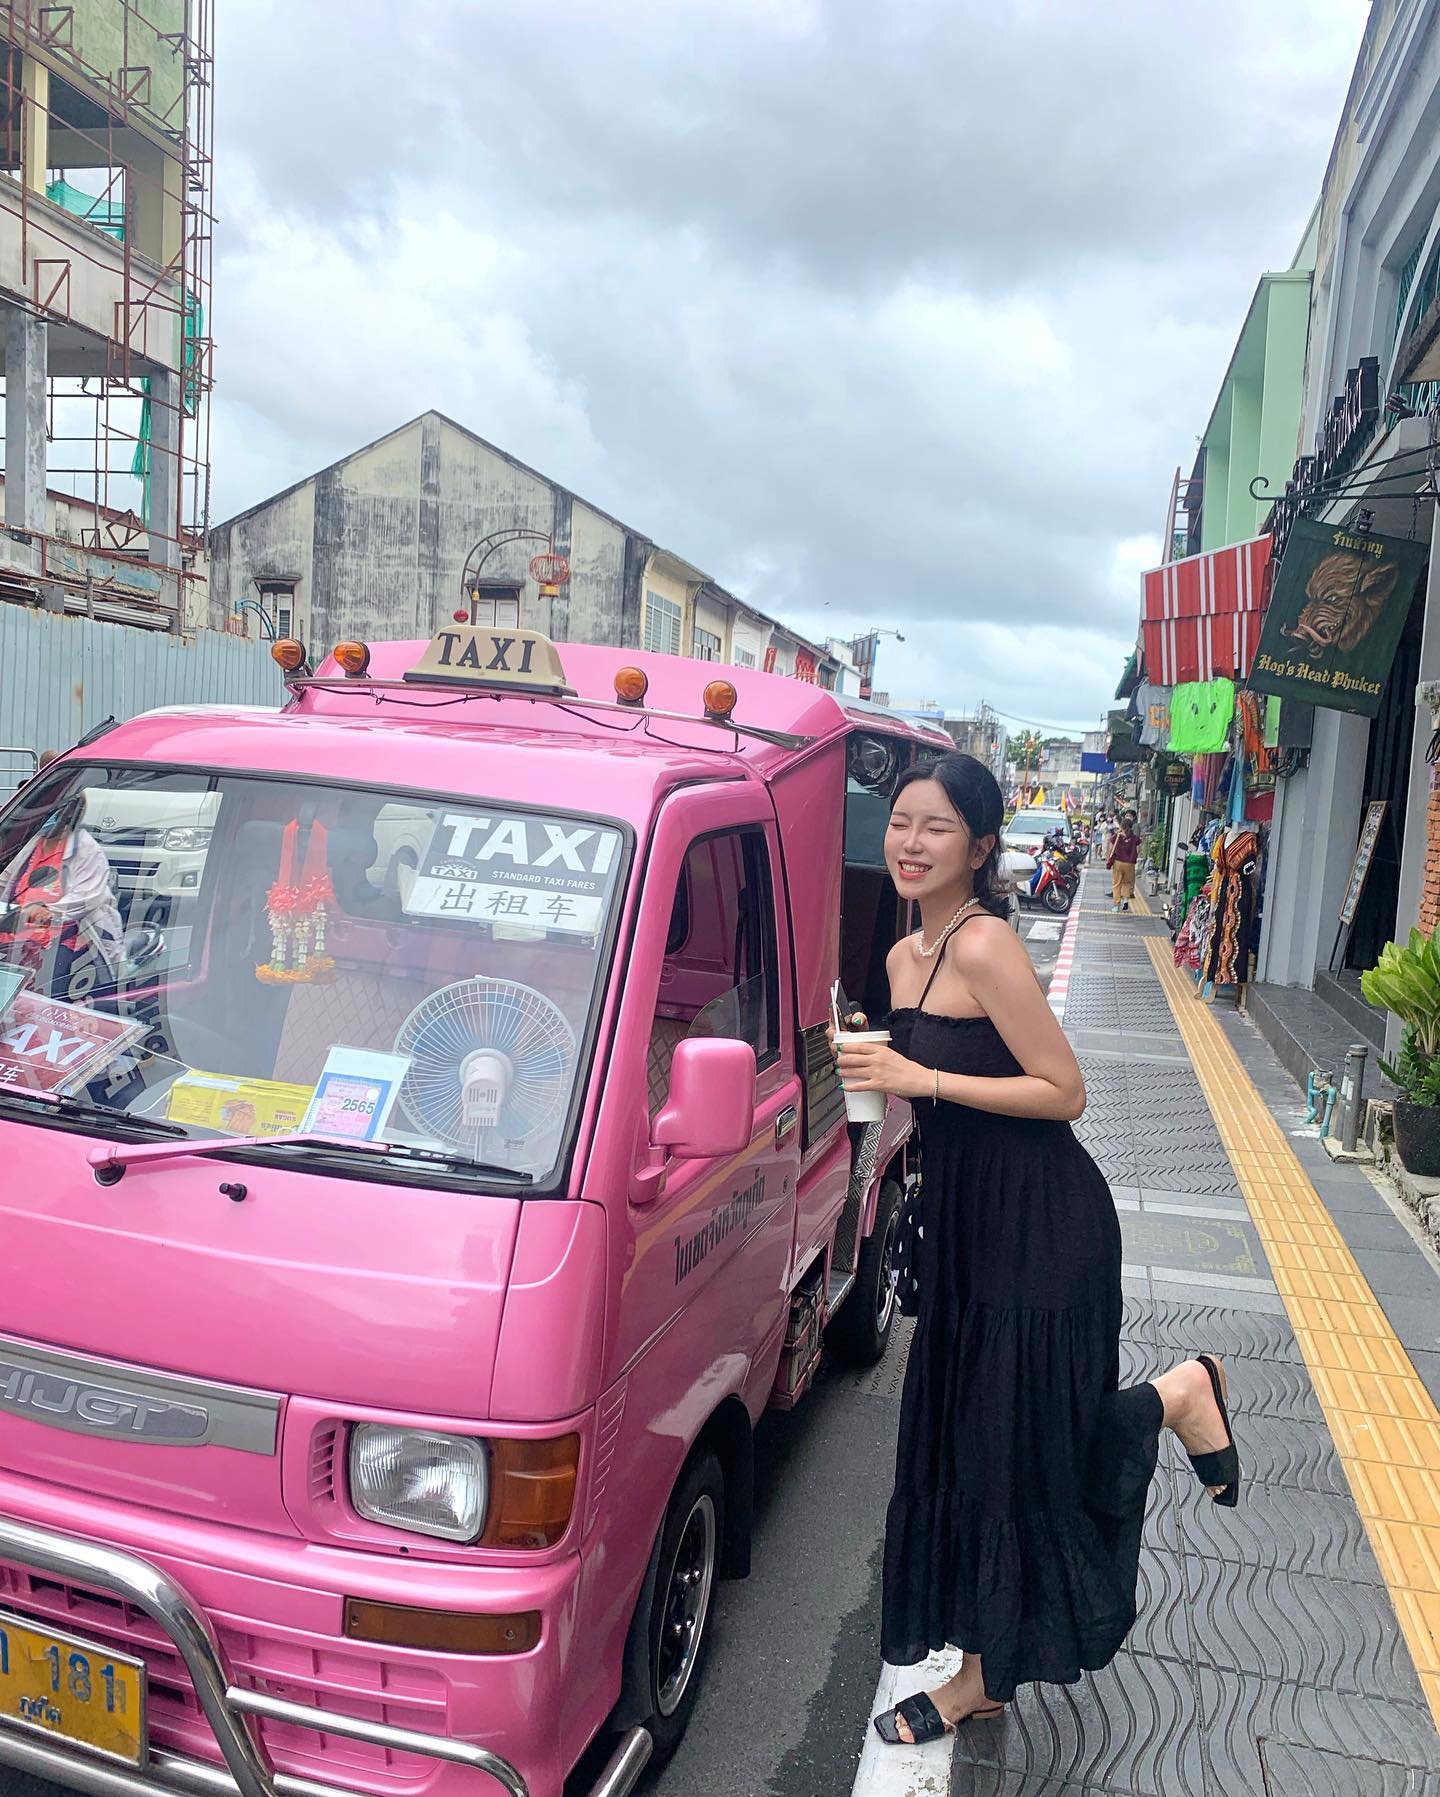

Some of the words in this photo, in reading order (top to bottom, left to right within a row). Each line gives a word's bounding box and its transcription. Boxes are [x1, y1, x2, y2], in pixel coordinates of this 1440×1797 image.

[437, 632, 537, 673] TAXI
[1257, 654, 1296, 677] Hog's
[1295, 662, 1330, 684] Head
[1331, 670, 1382, 695] Phuket
[442, 813, 618, 874] TAXI
[433, 866, 476, 879] TAXI
[491, 870, 541, 883] STANDARD
[543, 876, 565, 887] TAXI
[566, 880, 596, 890] FARES
[439, 883, 577, 924] 出租车
[0, 1023, 97, 1066] AXI
[341, 1098, 376, 1115] 2565
[44, 1645, 115, 1713] 181
